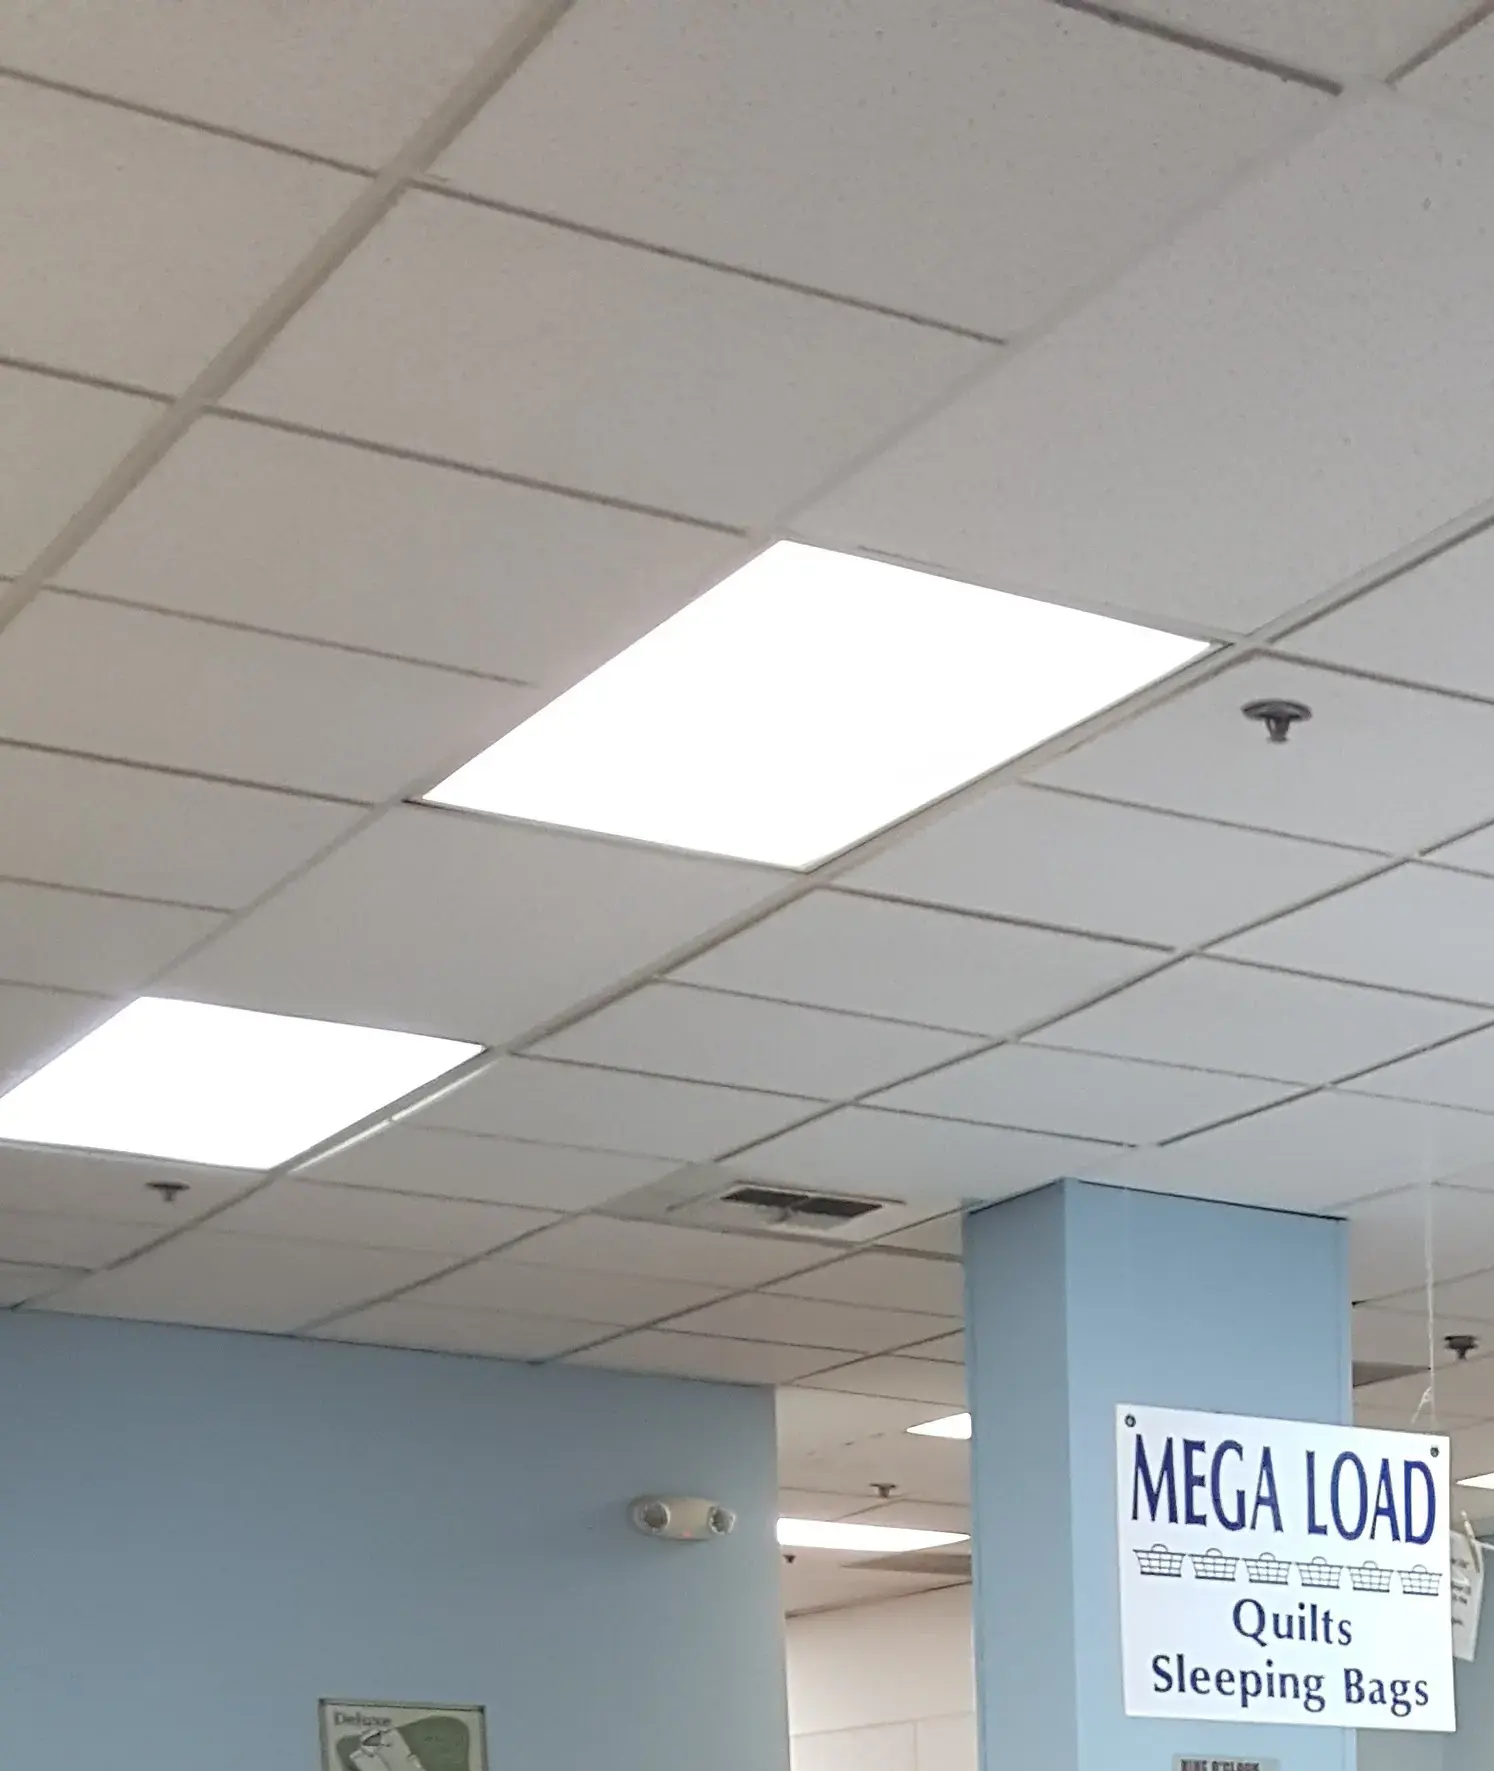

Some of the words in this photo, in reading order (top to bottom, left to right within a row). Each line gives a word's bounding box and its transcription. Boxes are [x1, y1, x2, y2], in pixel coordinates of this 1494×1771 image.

[1131, 1434, 1283, 1533] MEGA
[1305, 1449, 1437, 1546] LOAD
[1232, 1598, 1353, 1647] Quilts
[1152, 1654, 1326, 1713] Sleeping
[1344, 1667, 1430, 1717] Bags
[334, 1711, 392, 1728] Deluxe
